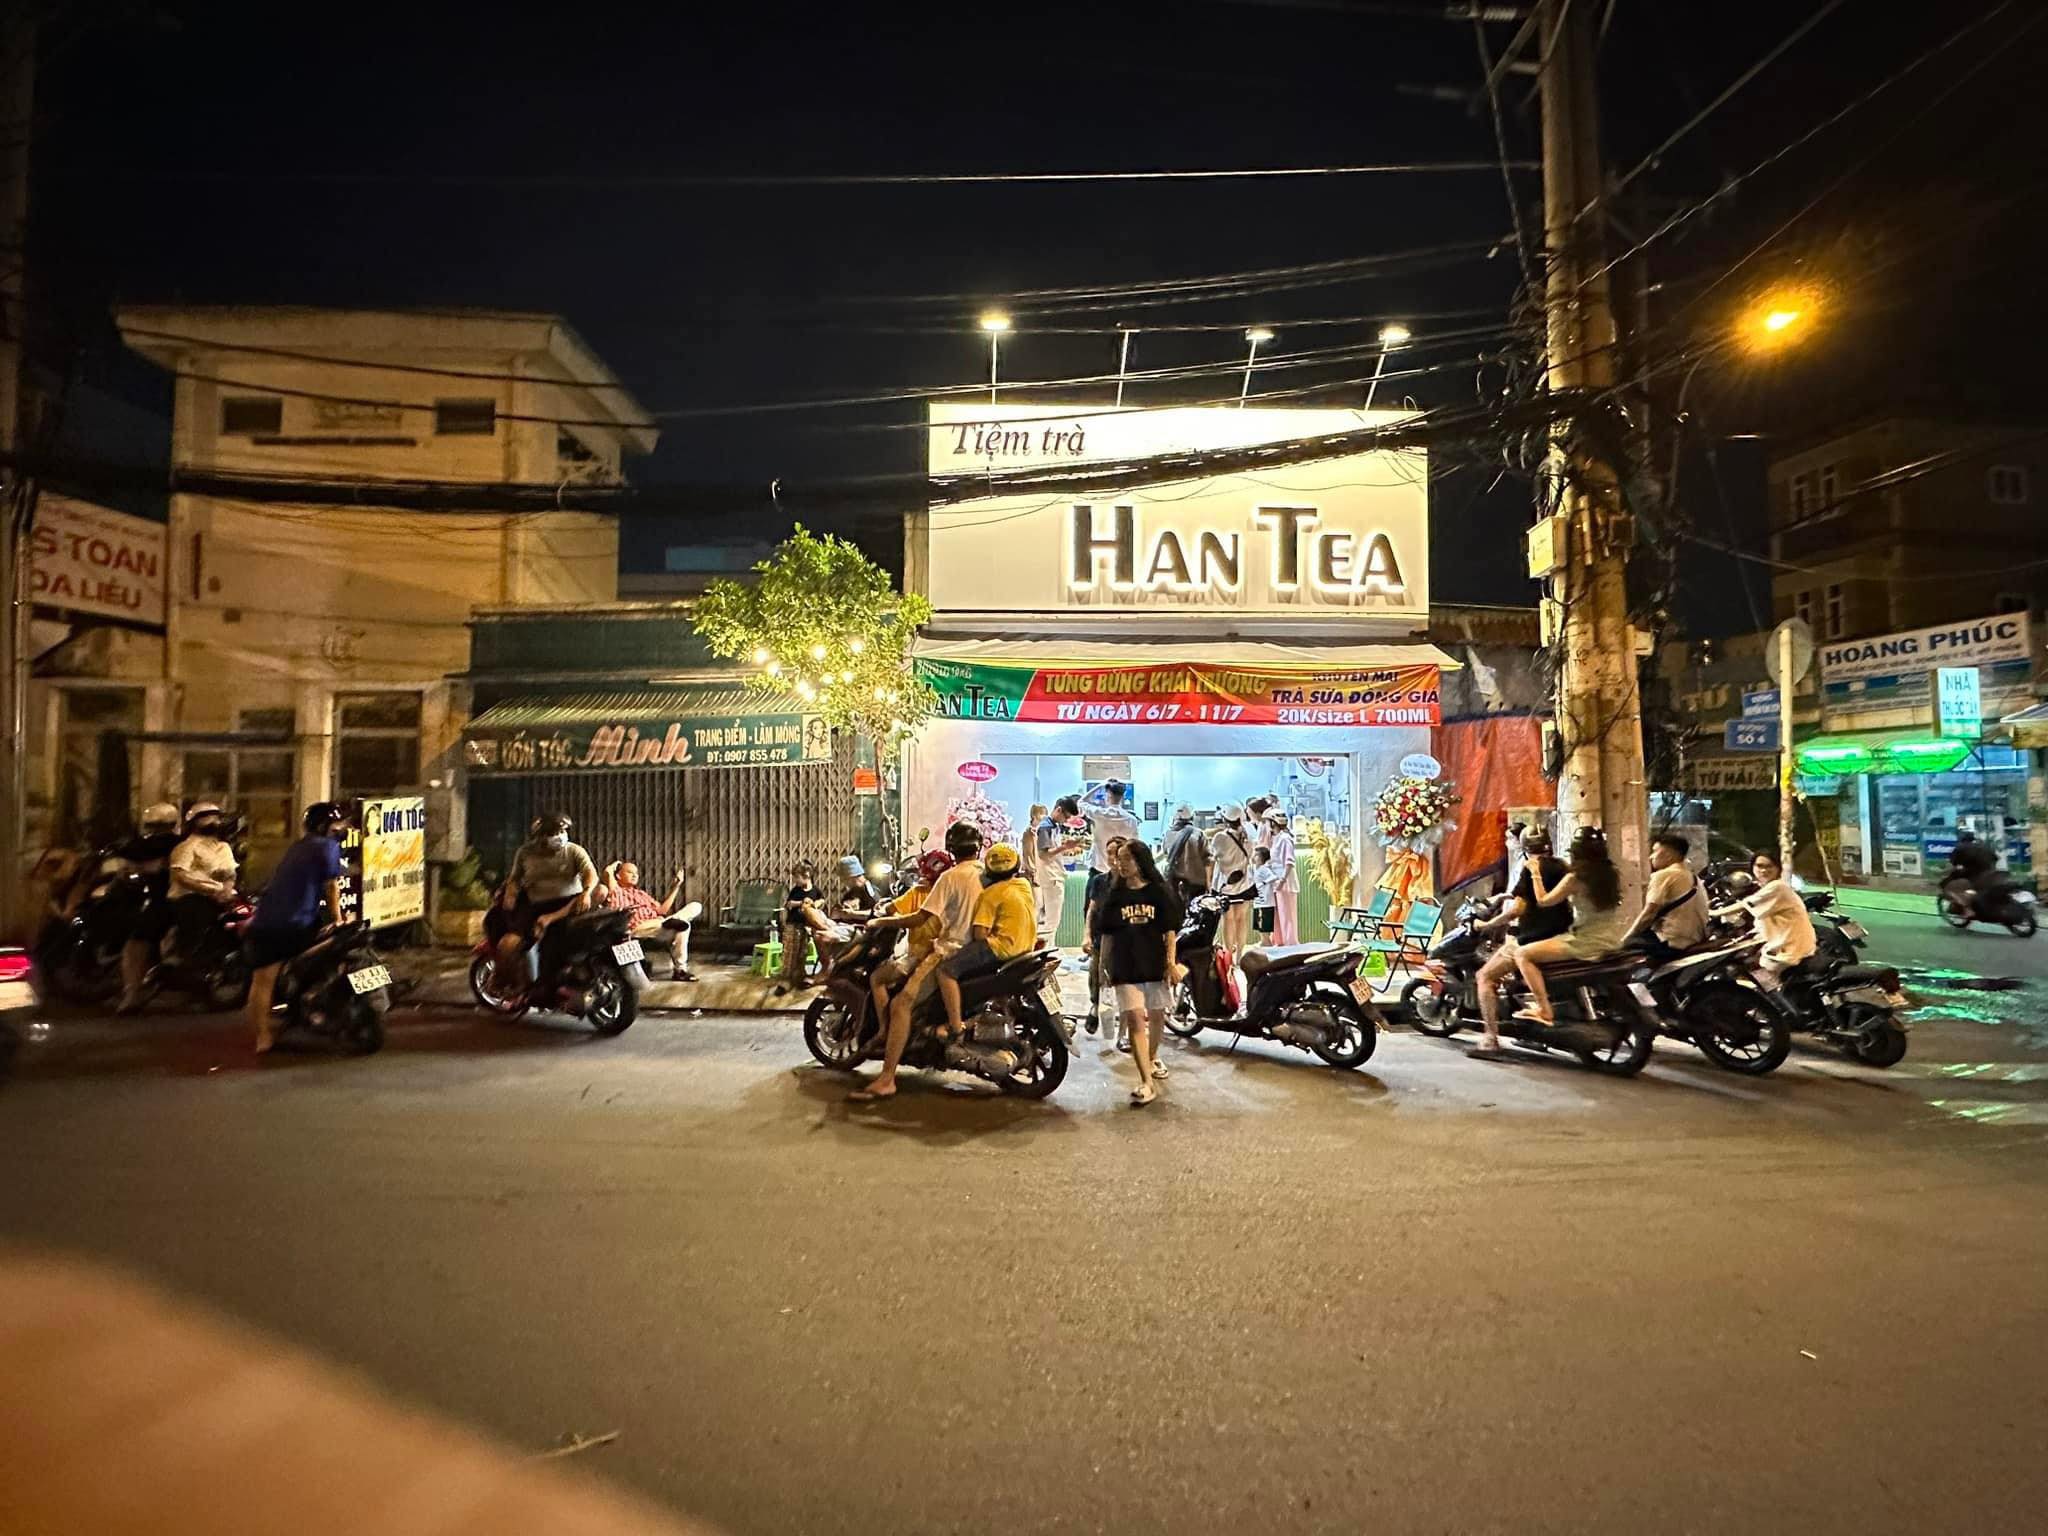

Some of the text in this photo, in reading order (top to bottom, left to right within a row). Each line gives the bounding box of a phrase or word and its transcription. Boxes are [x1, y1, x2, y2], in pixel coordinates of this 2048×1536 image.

[952, 423, 1085, 461] Tiệm trà
[1073, 505, 1404, 586] HAN TEA
[1826, 639, 1919, 666] HOÀNG
[1929, 619, 2018, 650] PHÚC
[1149, 671, 1191, 694] KHAI
[1945, 671, 1971, 691] NHÀ
[965, 685, 1010, 717] TEA
[1272, 686, 1304, 704] TRÀ
[1309, 686, 1344, 704] SỮA
[1407, 685, 1439, 704] GIÁ
[1057, 700, 1083, 720] TỪ
[1084, 701, 1143, 721] NGÀY
[1145, 703, 1181, 721] 6/7
[1199, 704, 1245, 721] 11/7
[1278, 708, 1433, 724] 20K/size L 700ML
[574, 722, 692, 766] Minh
[694, 728, 723, 747] TRANG
[725, 718, 747, 746] ĐIỂM
[754, 722, 773, 744] LÀM
[775, 721, 800, 744] MÓNG
[707, 749, 788, 763] ĐT: 0907 855 478
[1121, 904, 1155, 920] MIAMI
